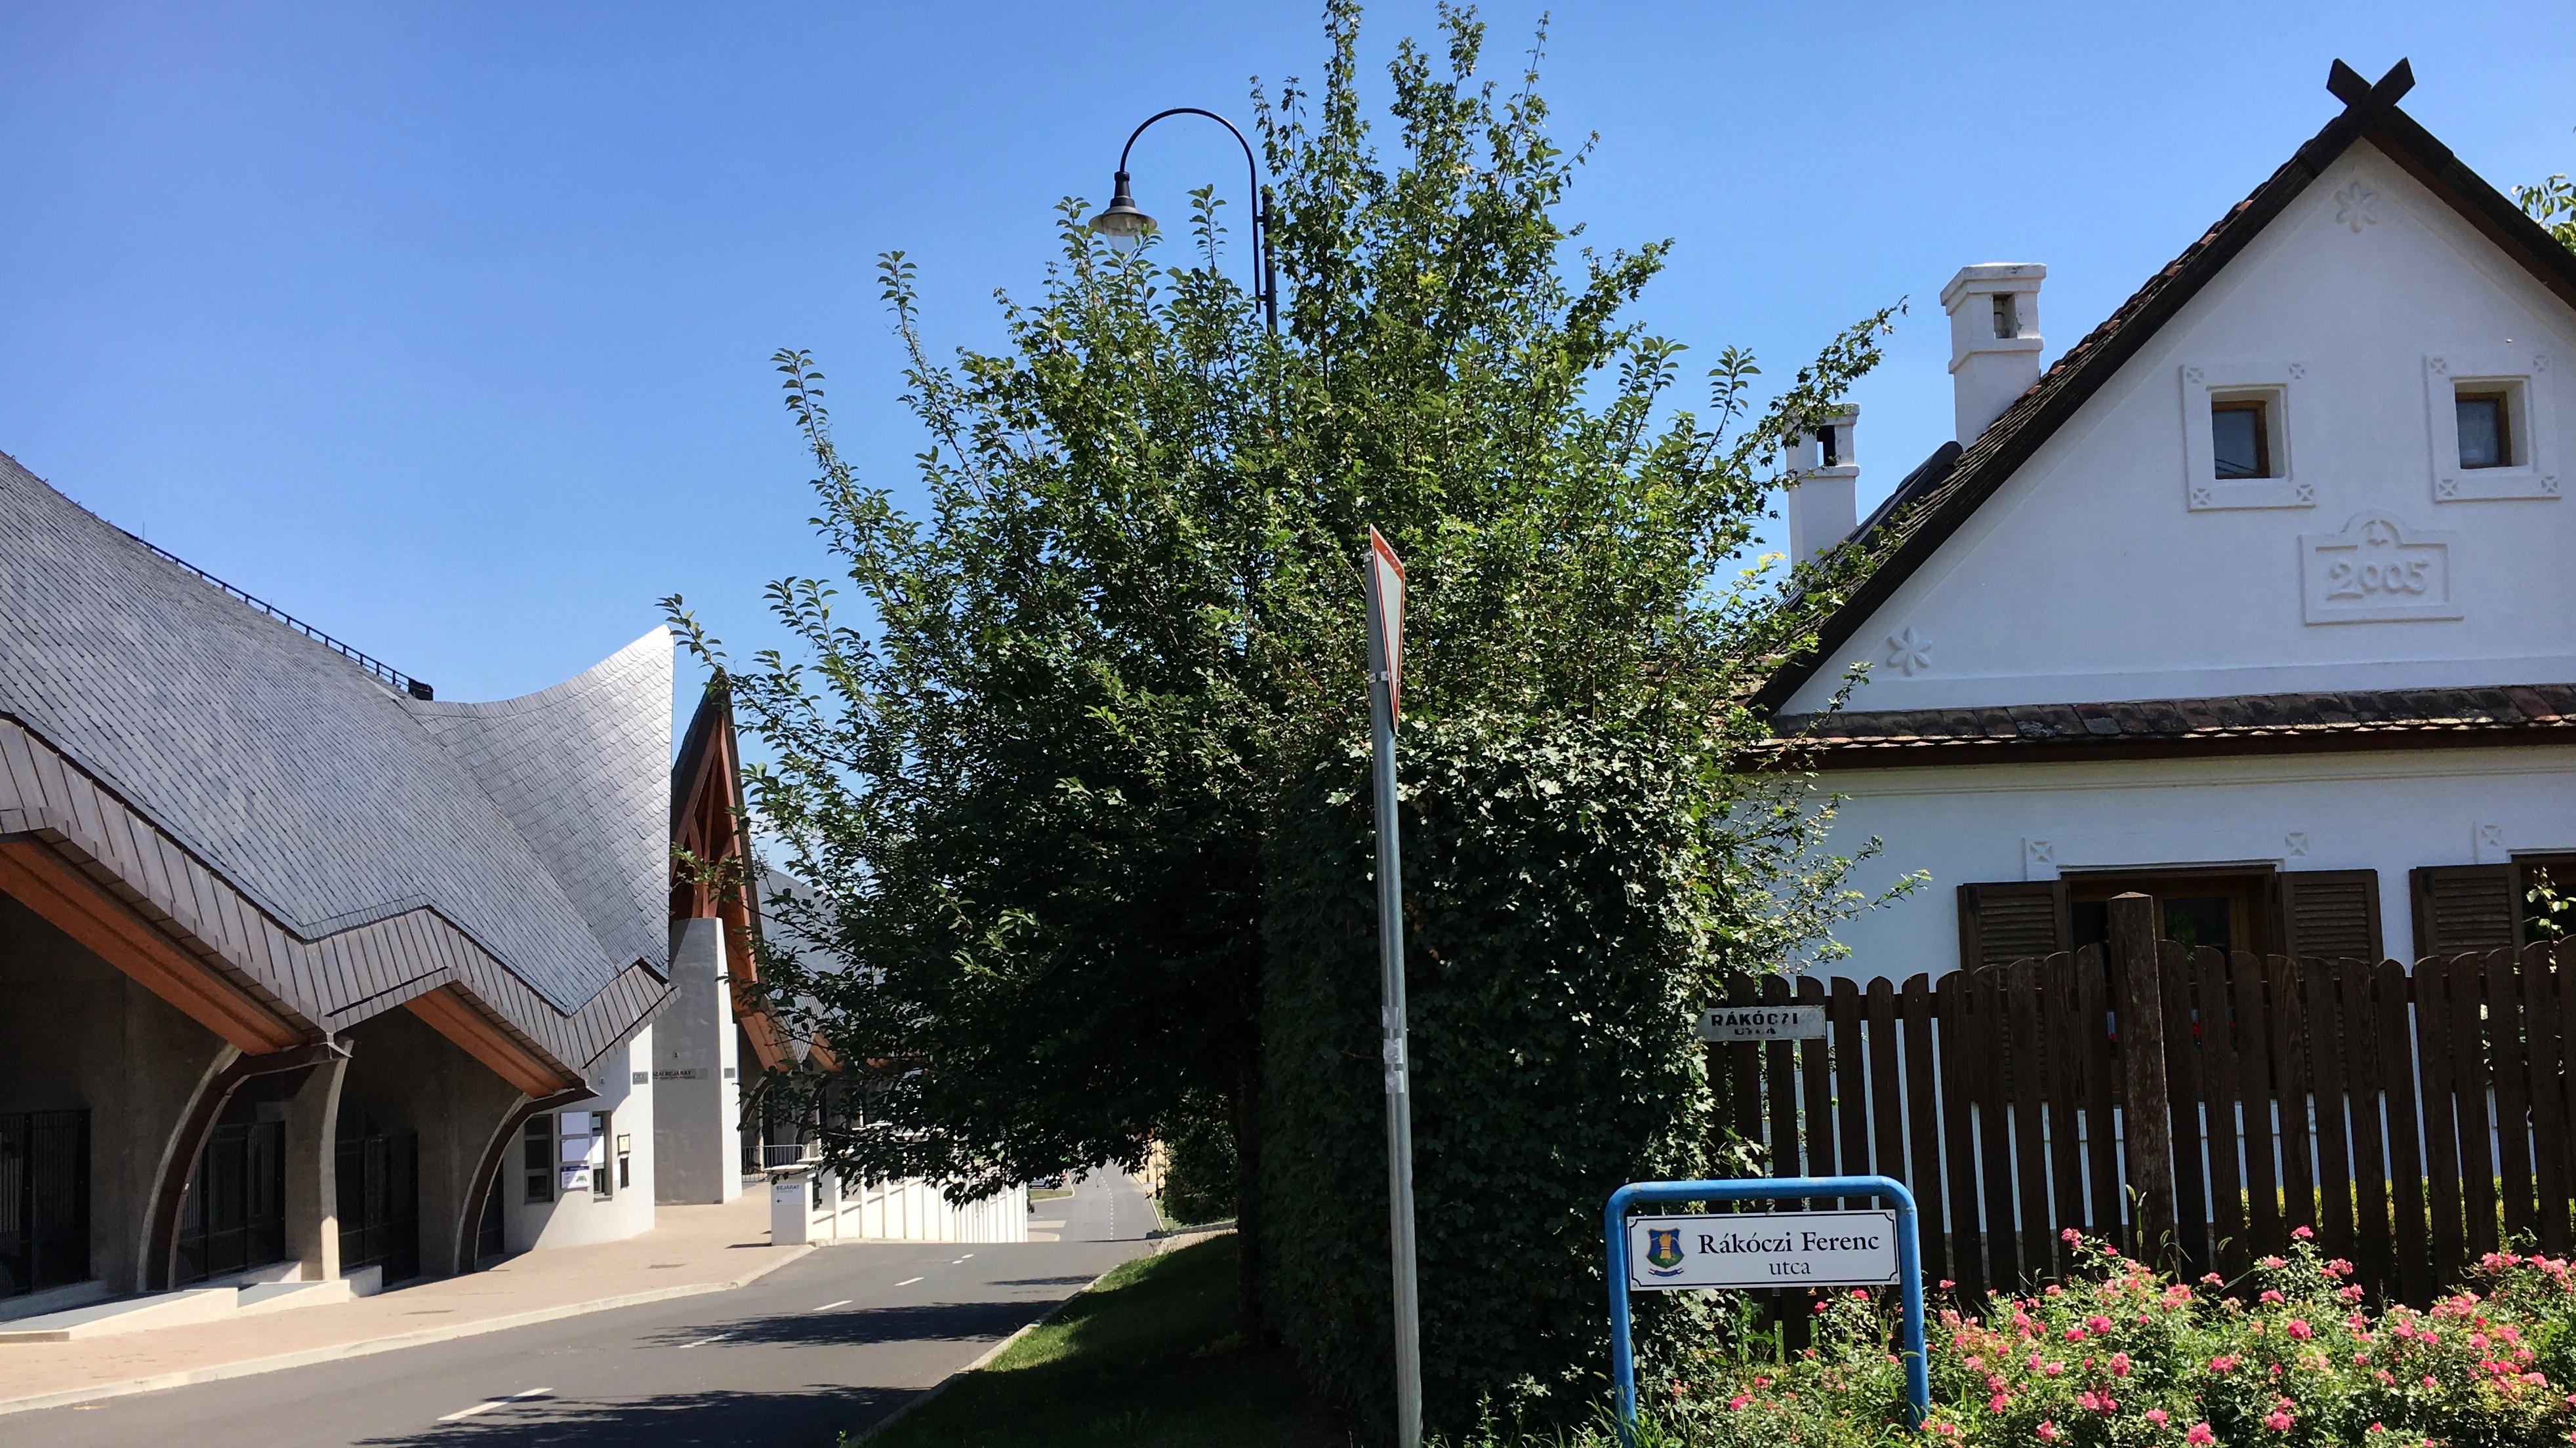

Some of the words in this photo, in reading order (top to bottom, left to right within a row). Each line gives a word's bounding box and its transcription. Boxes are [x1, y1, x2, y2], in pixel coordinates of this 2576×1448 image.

[2327, 561, 2429, 600] 2005
[1698, 1231, 1793, 1255] Rákóczi
[1801, 1232, 1879, 1251] Ferenc
[1768, 1260, 1811, 1275] utca
